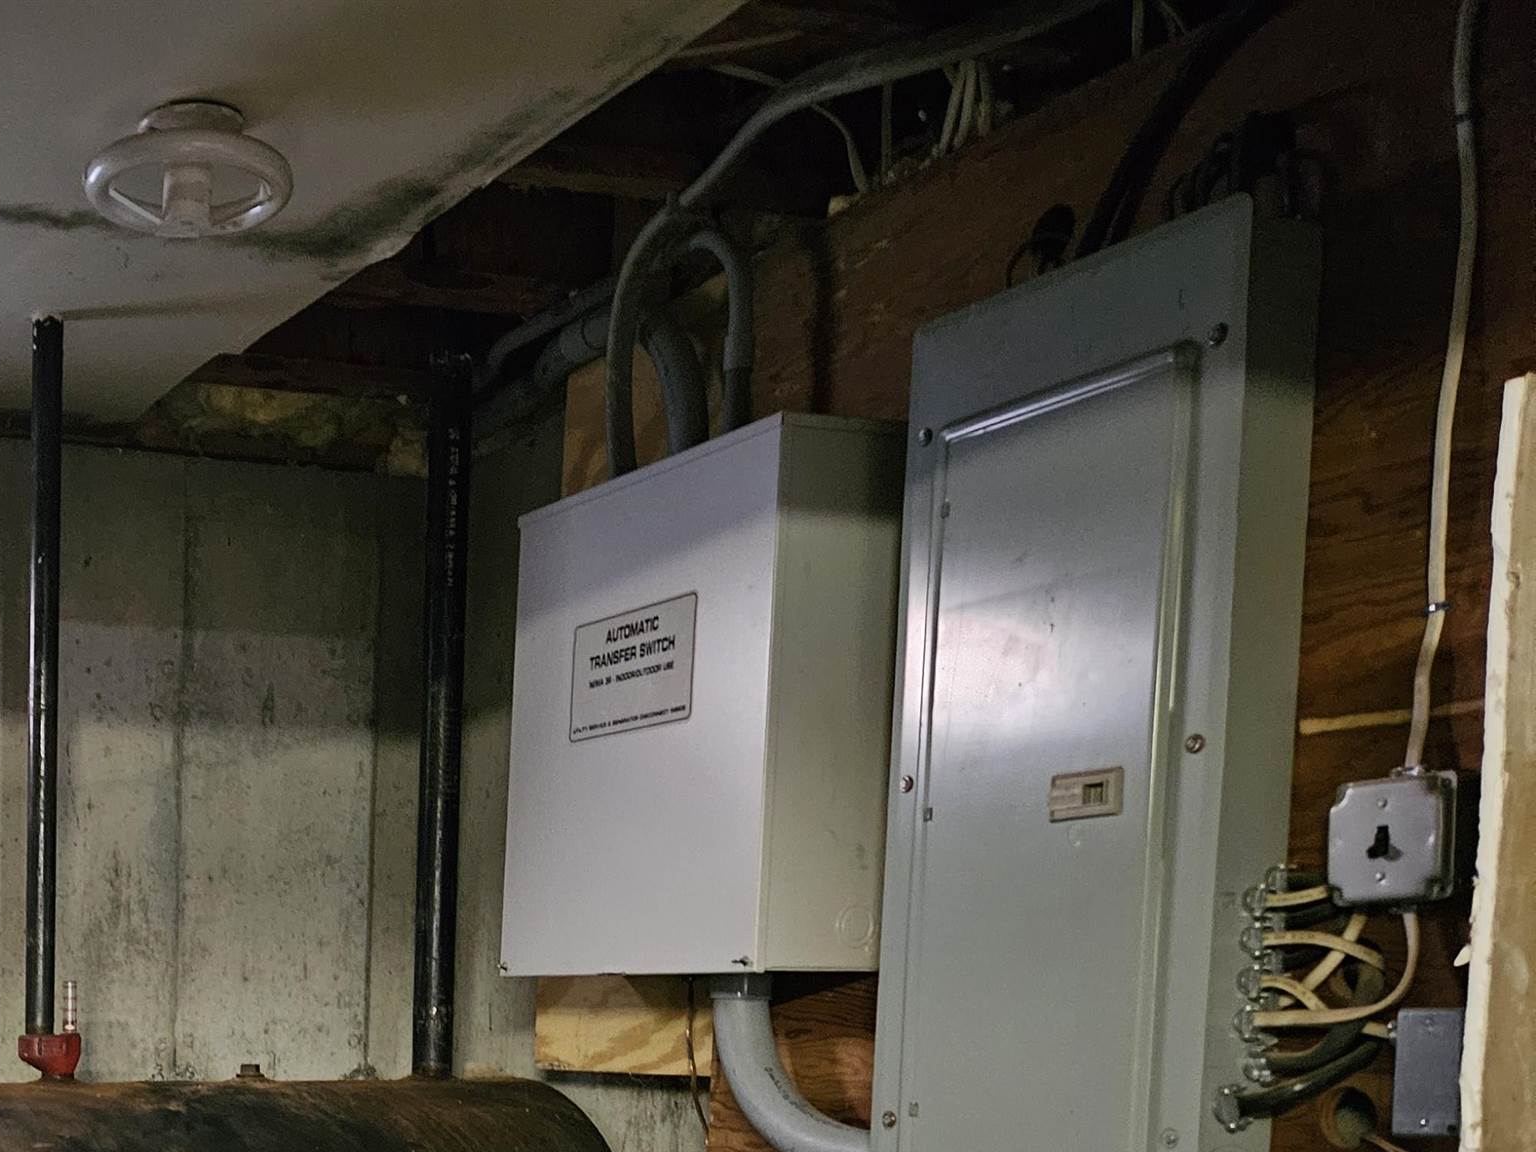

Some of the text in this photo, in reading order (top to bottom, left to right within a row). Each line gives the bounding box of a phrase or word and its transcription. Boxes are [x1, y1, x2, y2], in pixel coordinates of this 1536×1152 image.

[606, 615, 659, 645] AUTOMATIC
[590, 634, 676, 671] TRANSFER SWITCH
